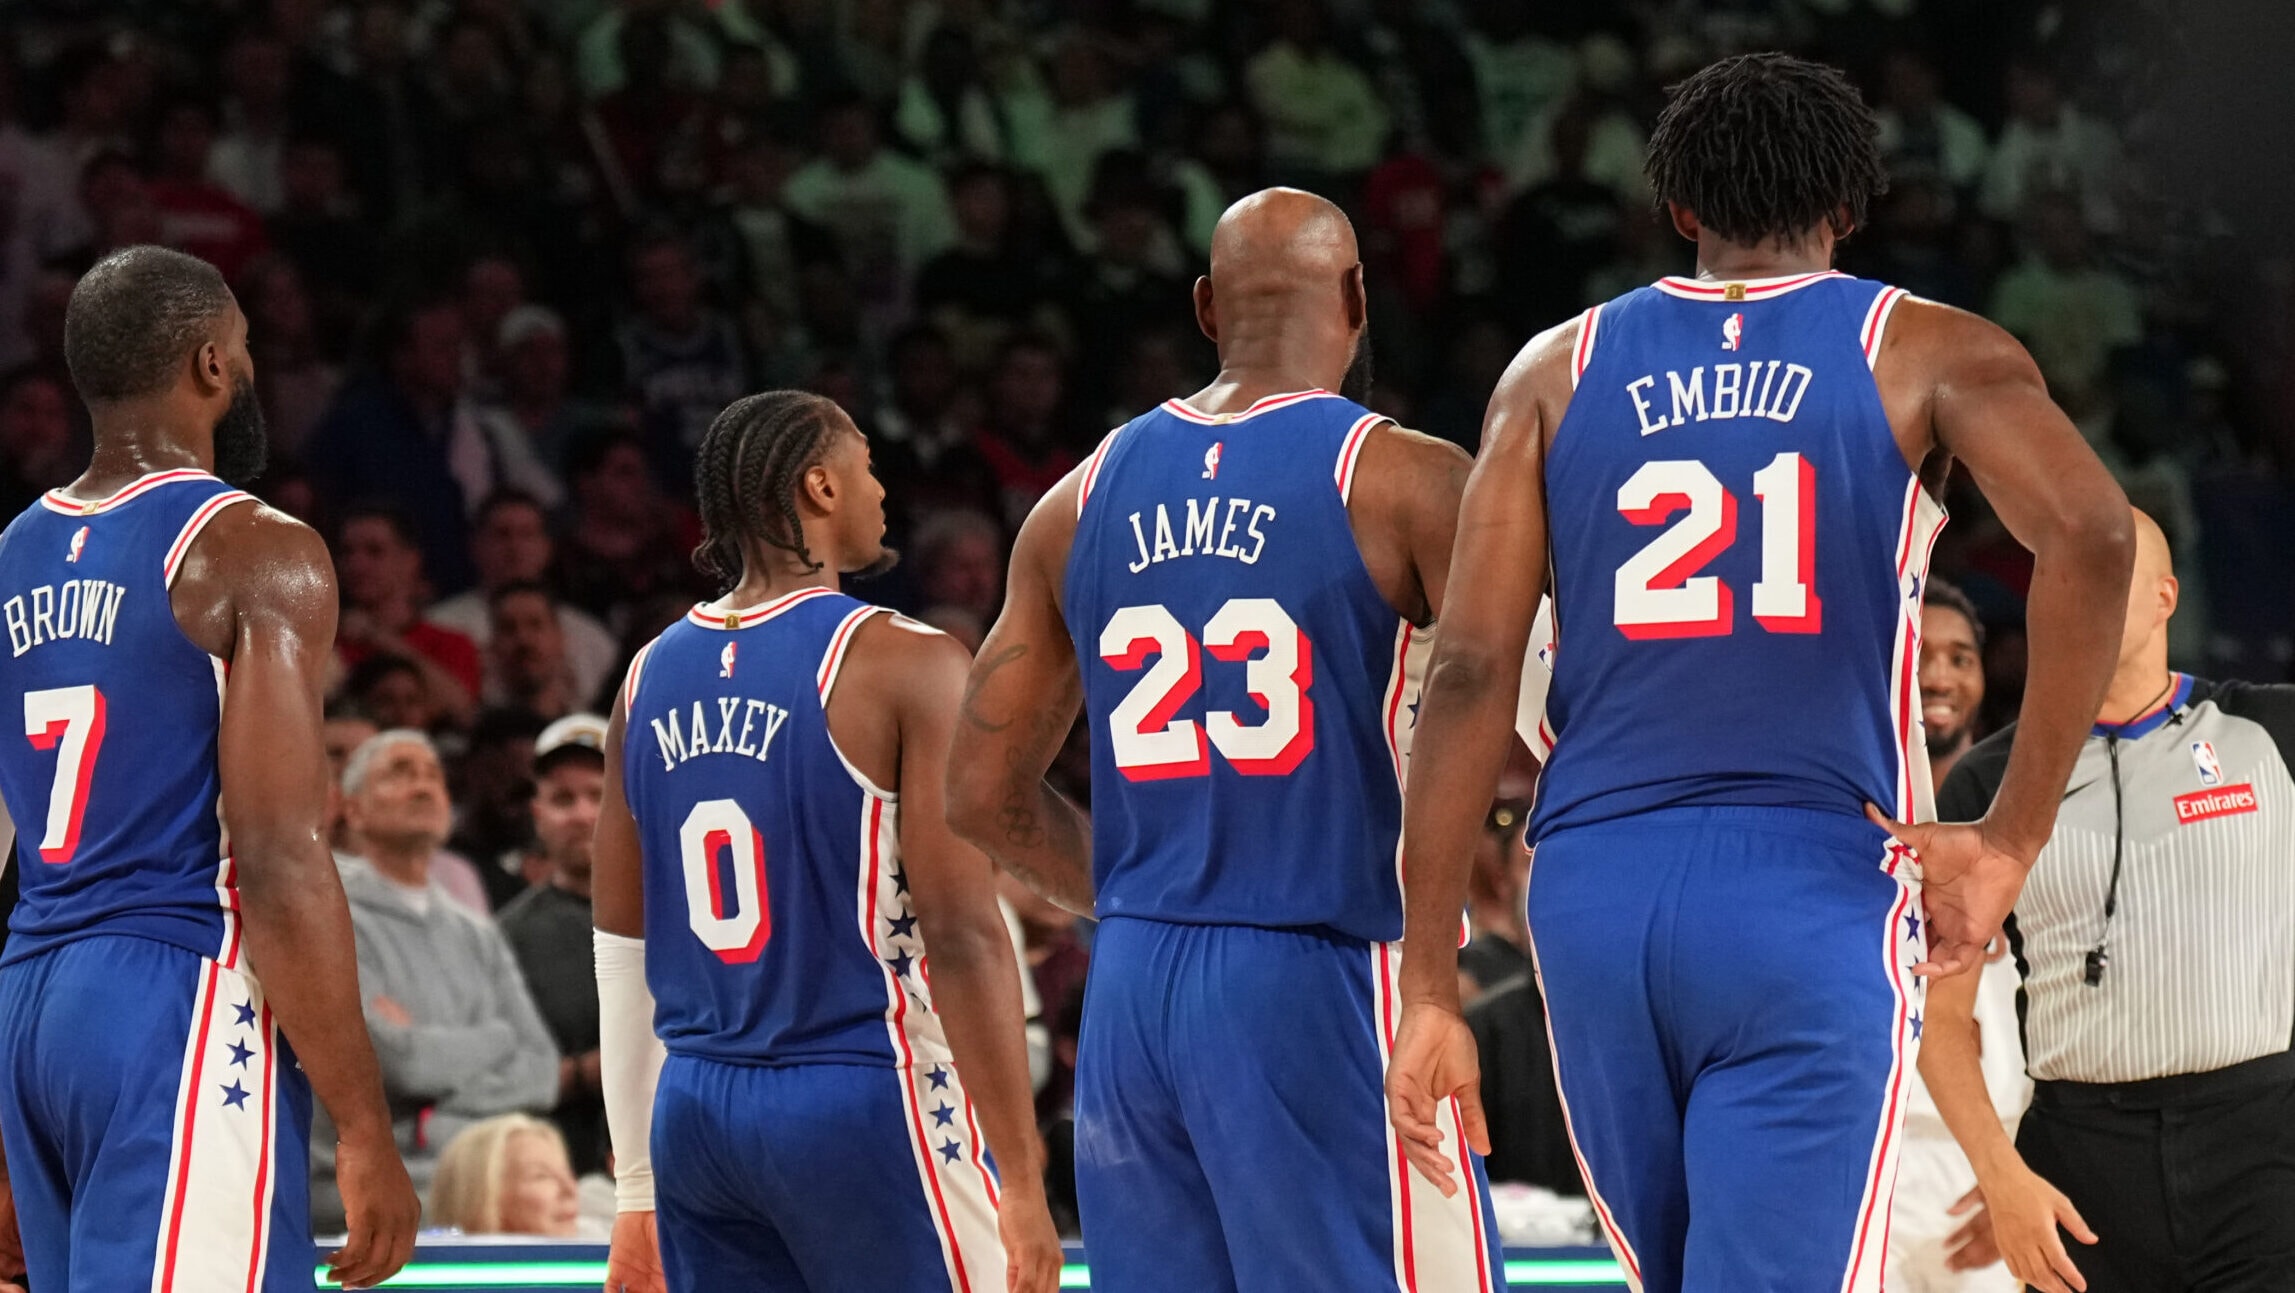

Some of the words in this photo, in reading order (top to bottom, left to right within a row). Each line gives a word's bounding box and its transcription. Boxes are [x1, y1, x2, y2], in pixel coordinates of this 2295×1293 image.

[1626, 360, 1812, 437] EMBIID
[1128, 497, 1276, 574] JAMES
[1614, 452, 1822, 641] 21
[3, 579, 126, 658] BROWN
[1100, 598, 1315, 783] 23
[24, 684, 107, 864] 7
[651, 697, 789, 773] MAXEY
[2176, 791, 2255, 819] Emirates
[679, 798, 772, 965] 0
